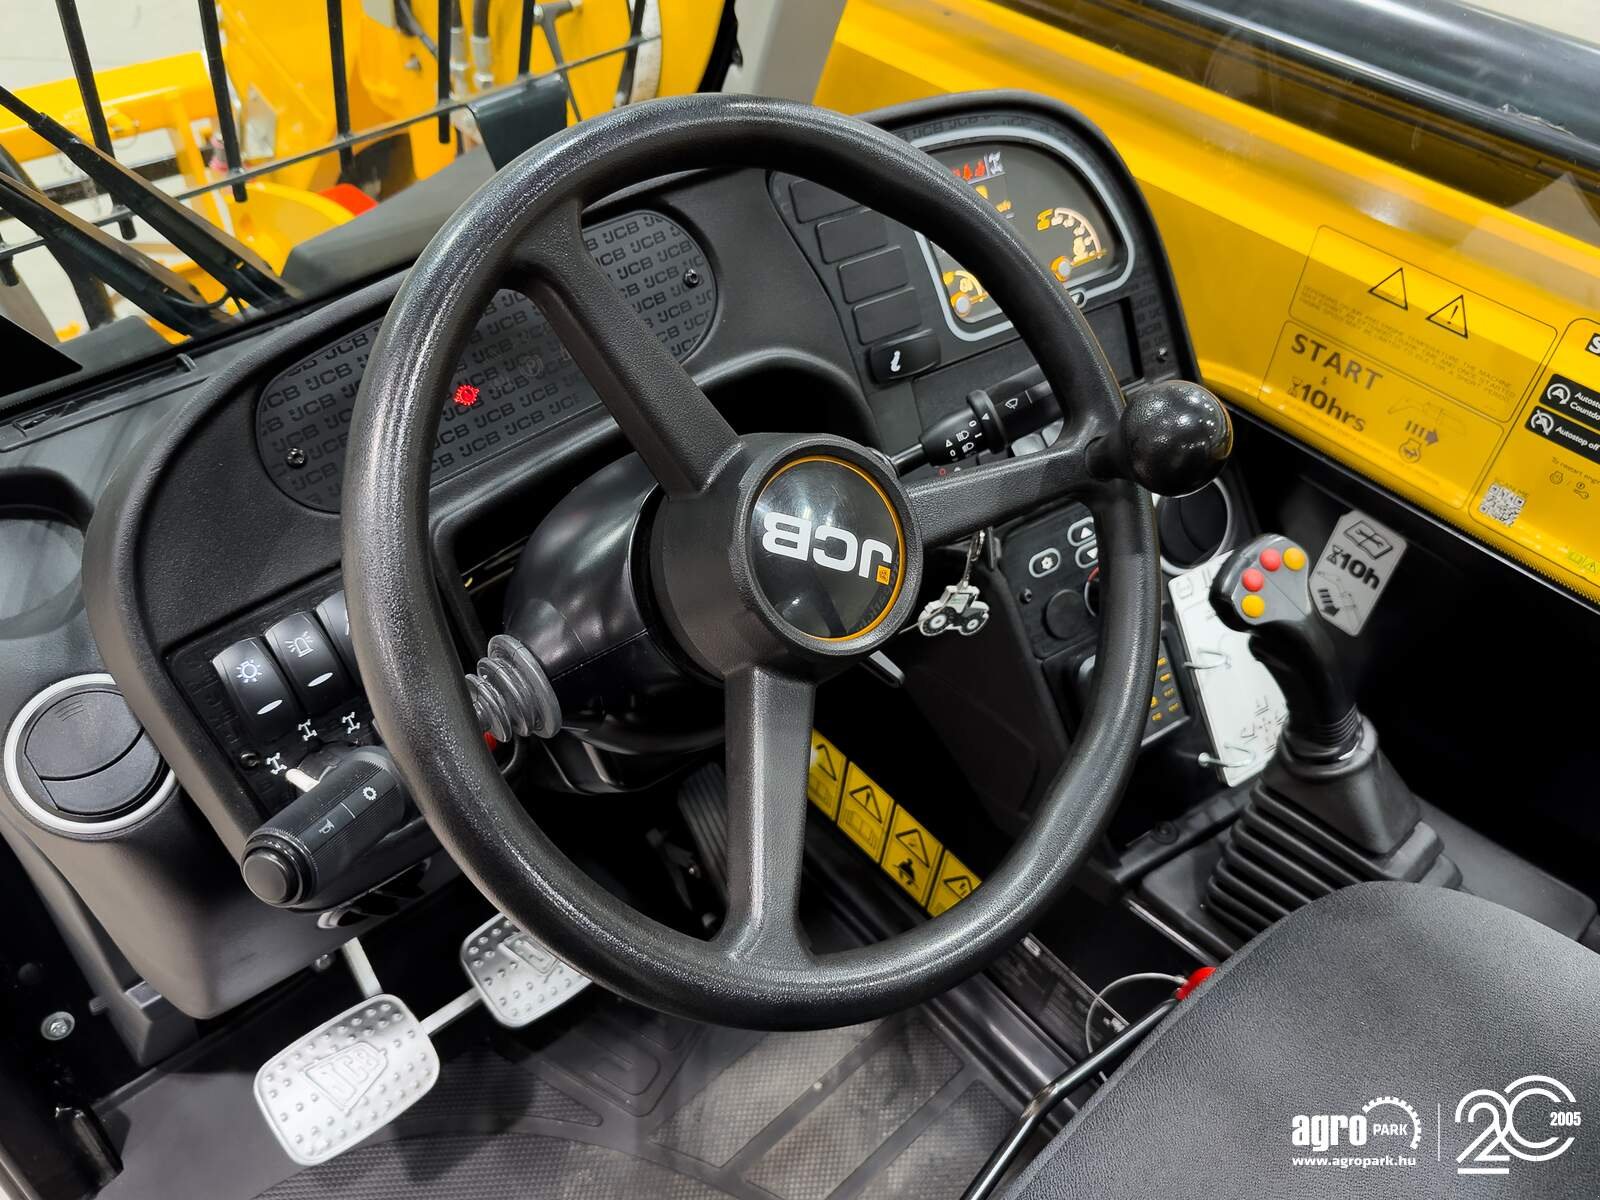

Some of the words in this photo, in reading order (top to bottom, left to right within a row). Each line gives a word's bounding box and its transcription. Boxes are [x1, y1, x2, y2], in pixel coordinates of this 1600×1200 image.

[602, 221, 640, 244] JCB
[630, 230, 667, 254] JCB
[617, 256, 654, 280] JCB
[657, 240, 693, 263] JCB
[644, 265, 681, 289] JCB
[487, 310, 528, 334] JCB
[657, 300, 693, 323] JCB
[1291, 333, 1383, 390] START
[305, 363, 353, 391] JCB
[288, 393, 336, 422] JCB
[474, 402, 516, 429] JCB
[520, 383, 559, 408] JCB
[1301, 384, 1366, 432] 10hrs
[459, 430, 501, 458] JCB
[504, 410, 545, 436] JCB
[1555, 426, 1588, 446] Autostop
[762, 511, 892, 586] JCB
[1340, 552, 1380, 591] 10h
